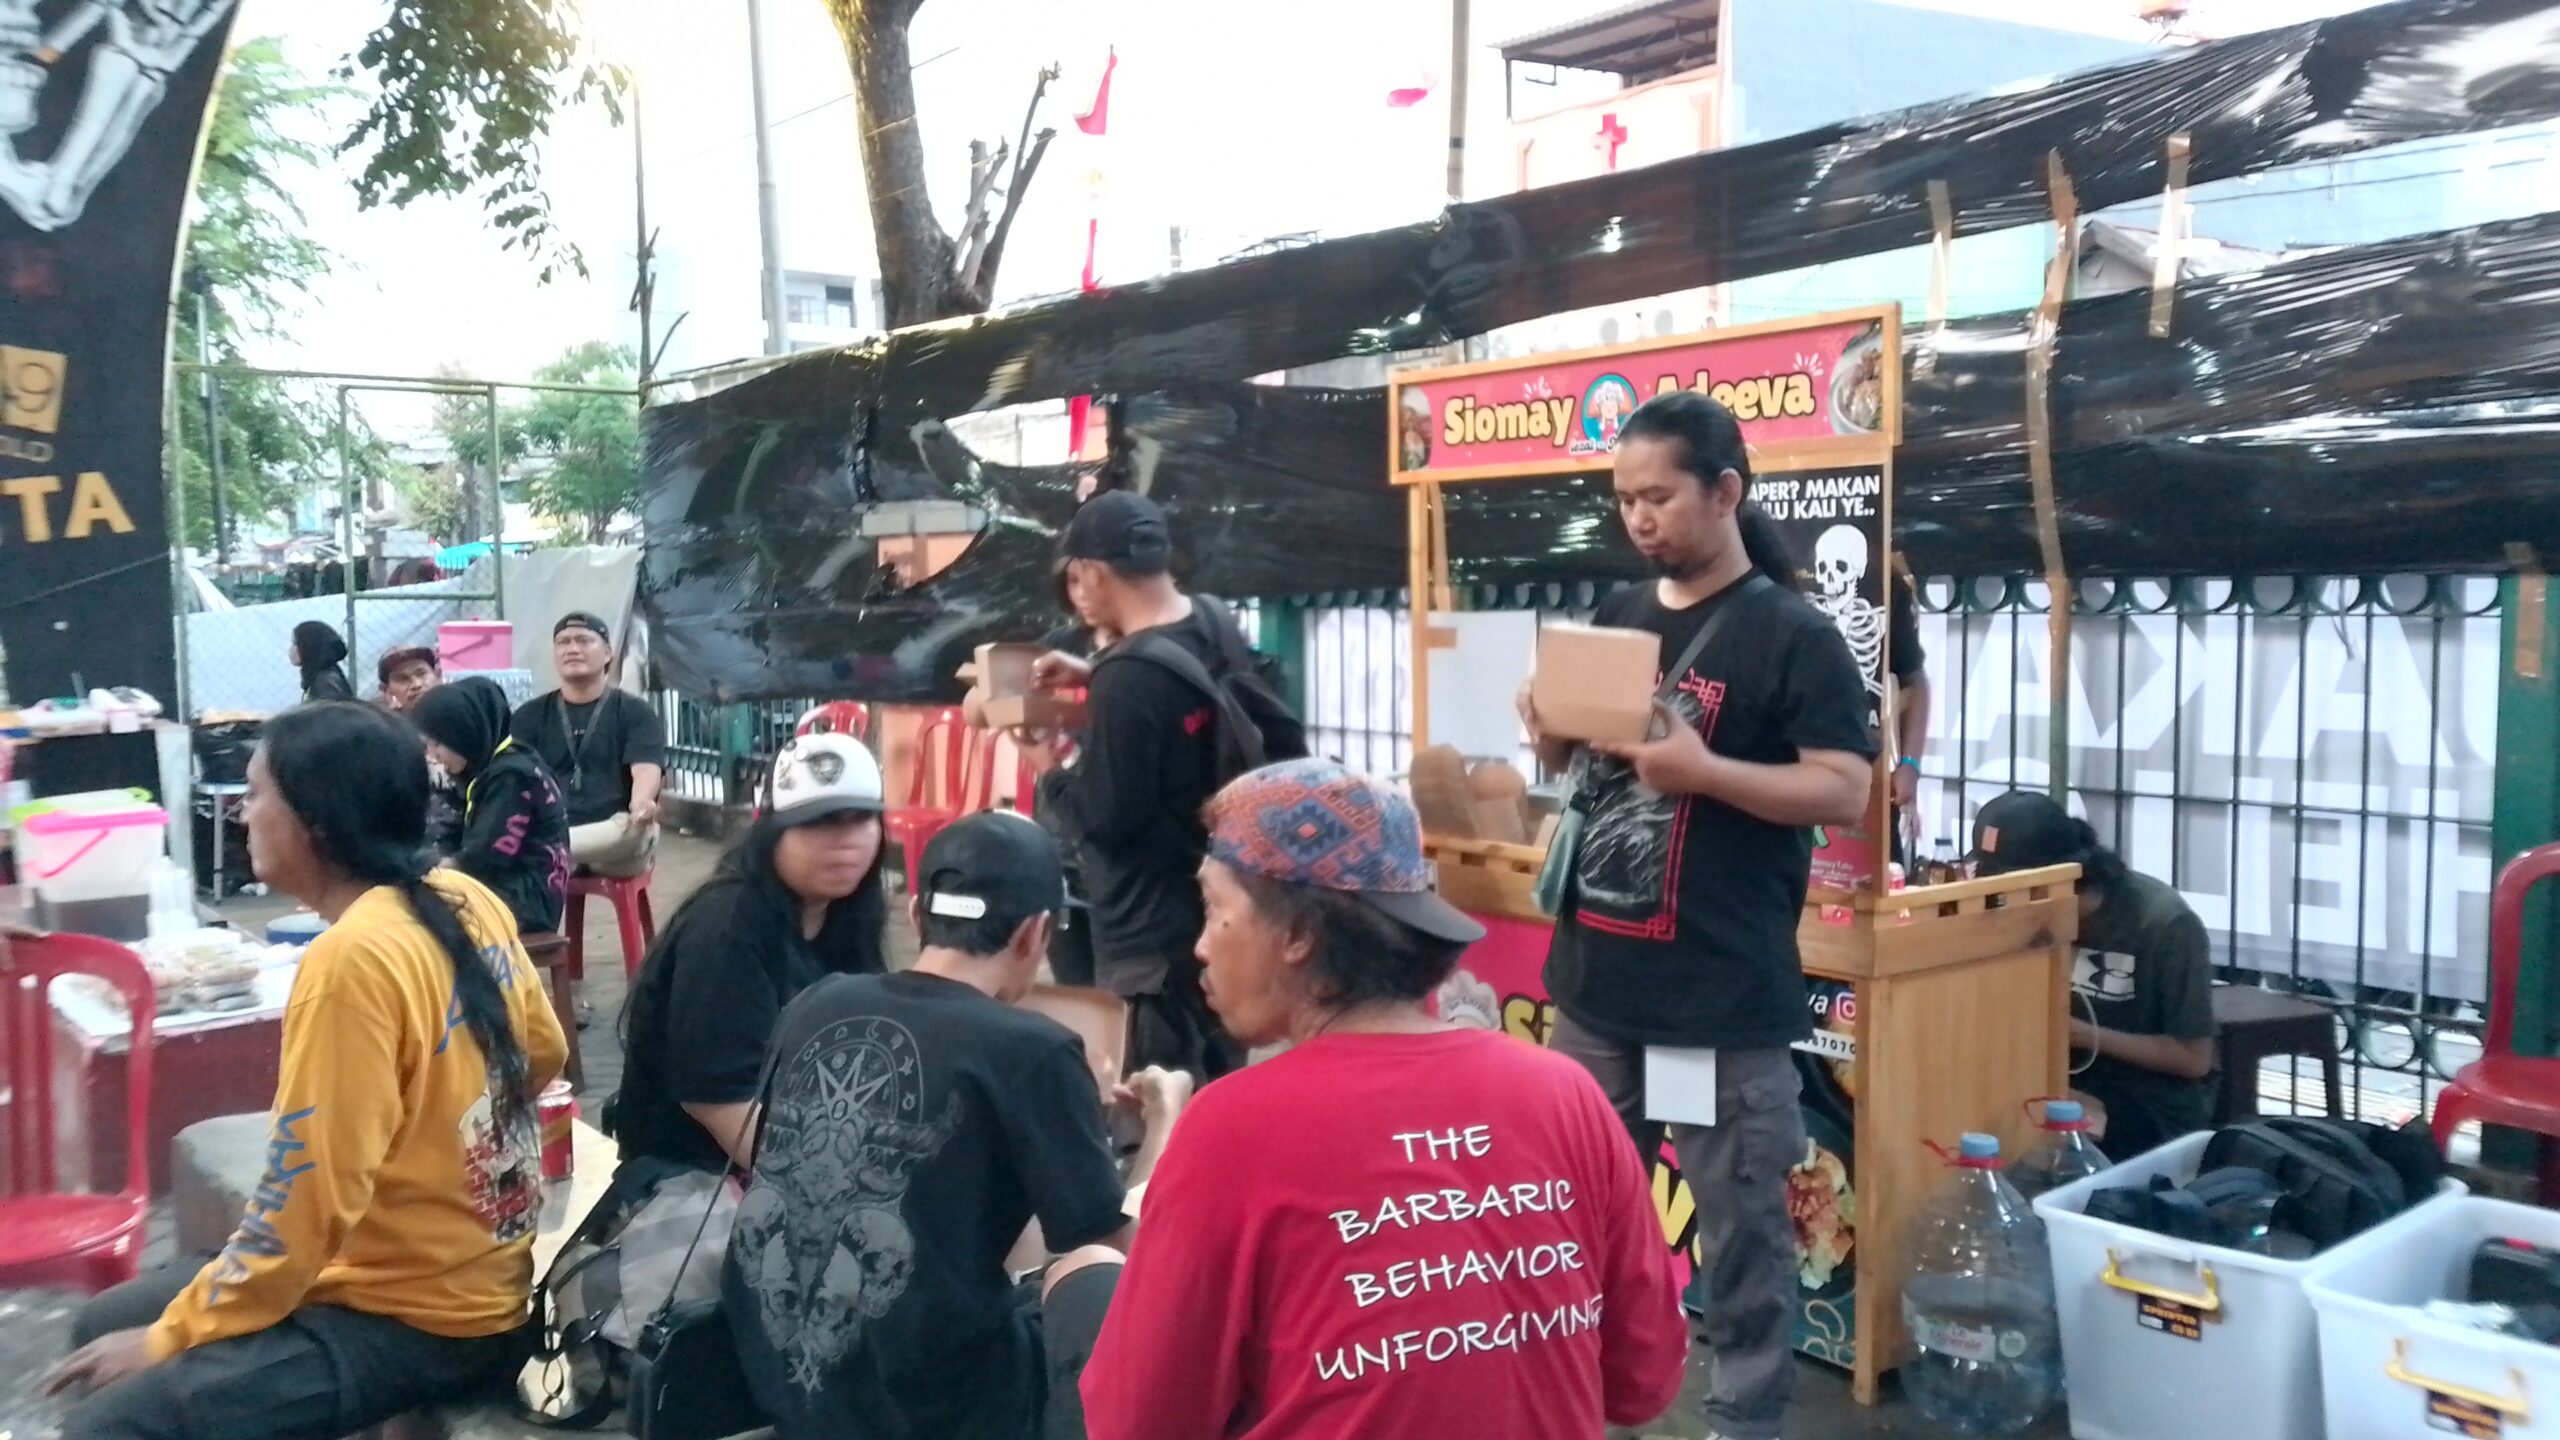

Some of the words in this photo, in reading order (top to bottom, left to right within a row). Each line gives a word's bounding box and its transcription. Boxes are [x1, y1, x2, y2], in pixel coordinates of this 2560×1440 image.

[1443, 394, 1575, 448] Siomay
[0, 472, 136, 542] TA
[1748, 480, 1800, 501] APER?
[1804, 474, 1880, 499] MAKAN
[1793, 498, 1837, 519] KALI
[1841, 496, 1876, 517] YE..
[1392, 1124, 1492, 1164] THE
[1328, 1178, 1577, 1244] BARBARIC
[1344, 1241, 1585, 1309] BEHAVIOR
